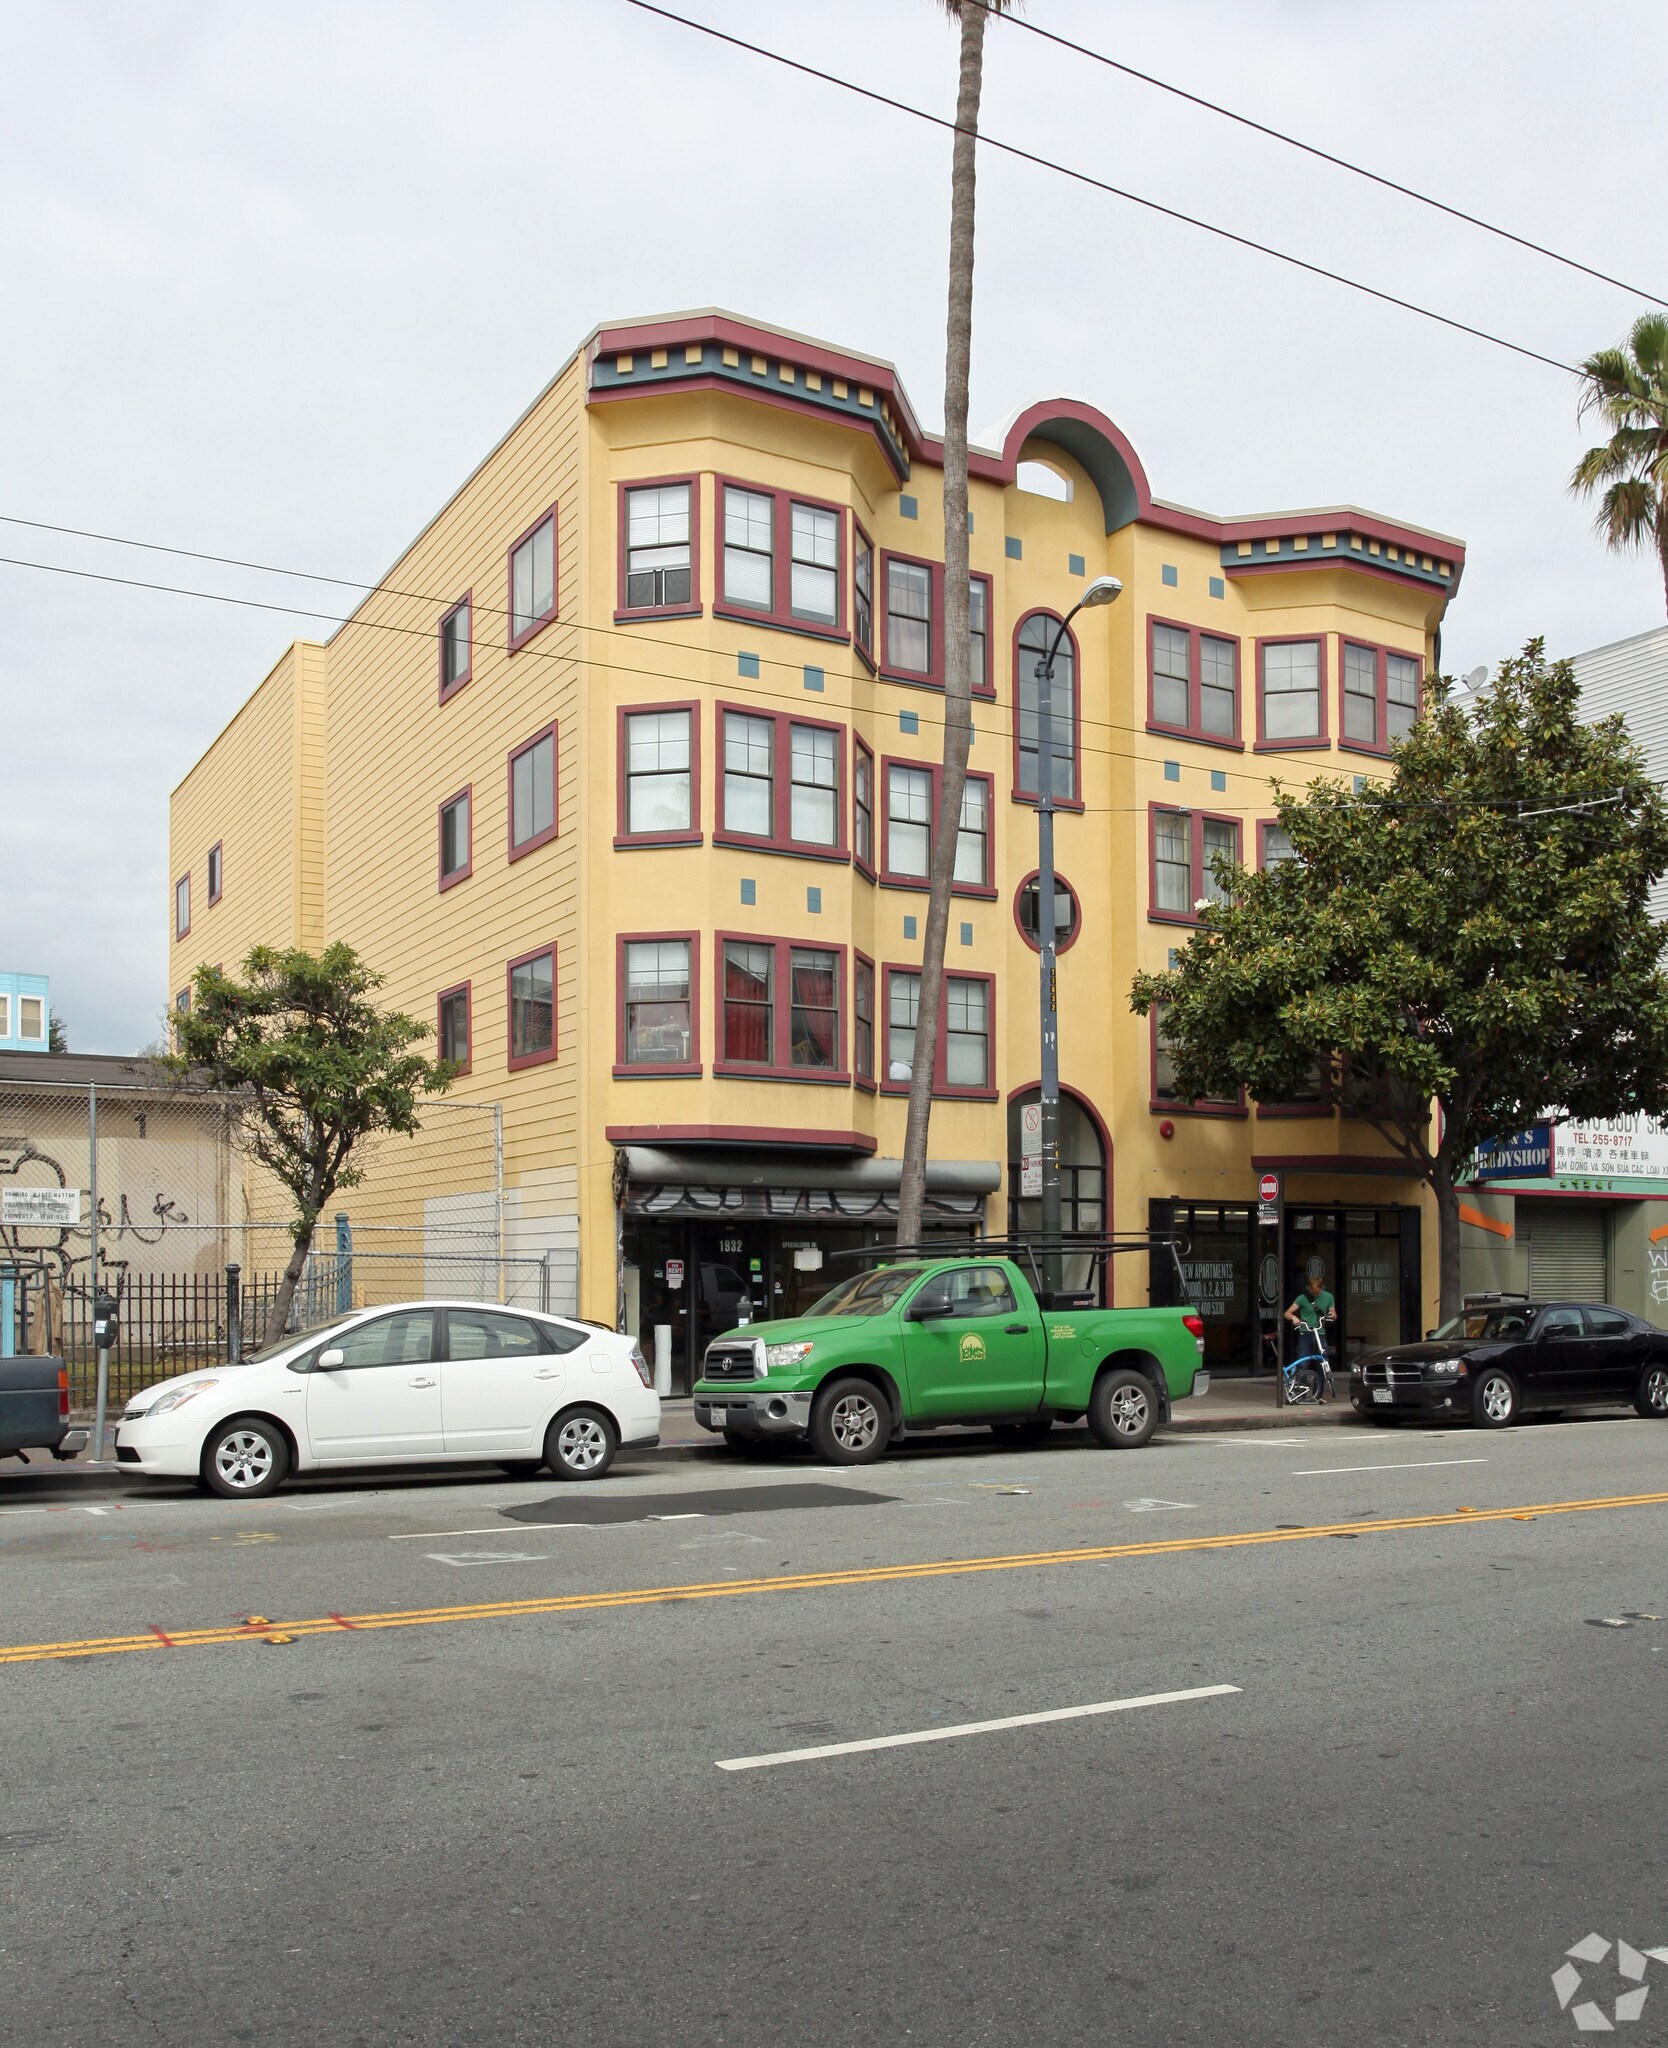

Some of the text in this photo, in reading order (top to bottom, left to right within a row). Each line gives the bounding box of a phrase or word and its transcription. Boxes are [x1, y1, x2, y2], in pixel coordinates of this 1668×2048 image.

[1524, 1130, 1534, 1144] S
[719, 1239, 743, 1252] 1932
[1179, 1263, 1234, 1279] NEW APARTMENTS
[1357, 1263, 1372, 1278] NEW
[1225, 1281, 1234, 1297] BR
[1351, 1279, 1359, 1294] IN
[1360, 1279, 1374, 1294] THE
